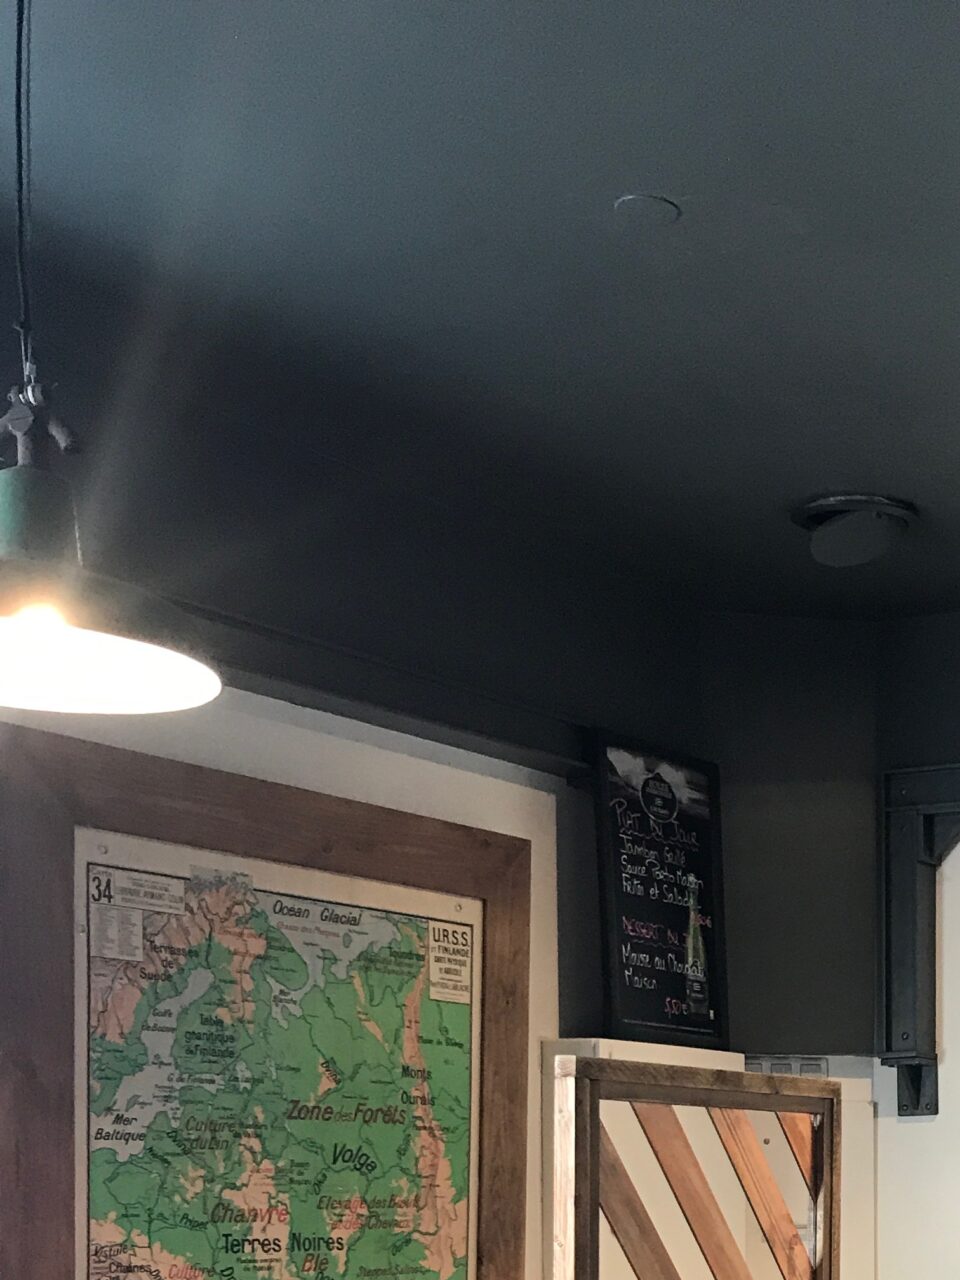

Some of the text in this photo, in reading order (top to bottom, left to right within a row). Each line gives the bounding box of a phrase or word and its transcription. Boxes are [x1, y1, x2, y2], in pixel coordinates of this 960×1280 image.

[91, 876, 113, 903] 34
[320, 908, 362, 926] Glacial
[402, 1066, 432, 1080] Monts
[112, 1114, 138, 1126] Mer
[287, 1100, 334, 1121] Zone
[94, 1128, 146, 1144] Baltique
[332, 1143, 378, 1174] Volga
[211, 1201, 289, 1224] Chanvre
[222, 1232, 345, 1254] Terres Noires
[302, 1252, 329, 1273] Blé
